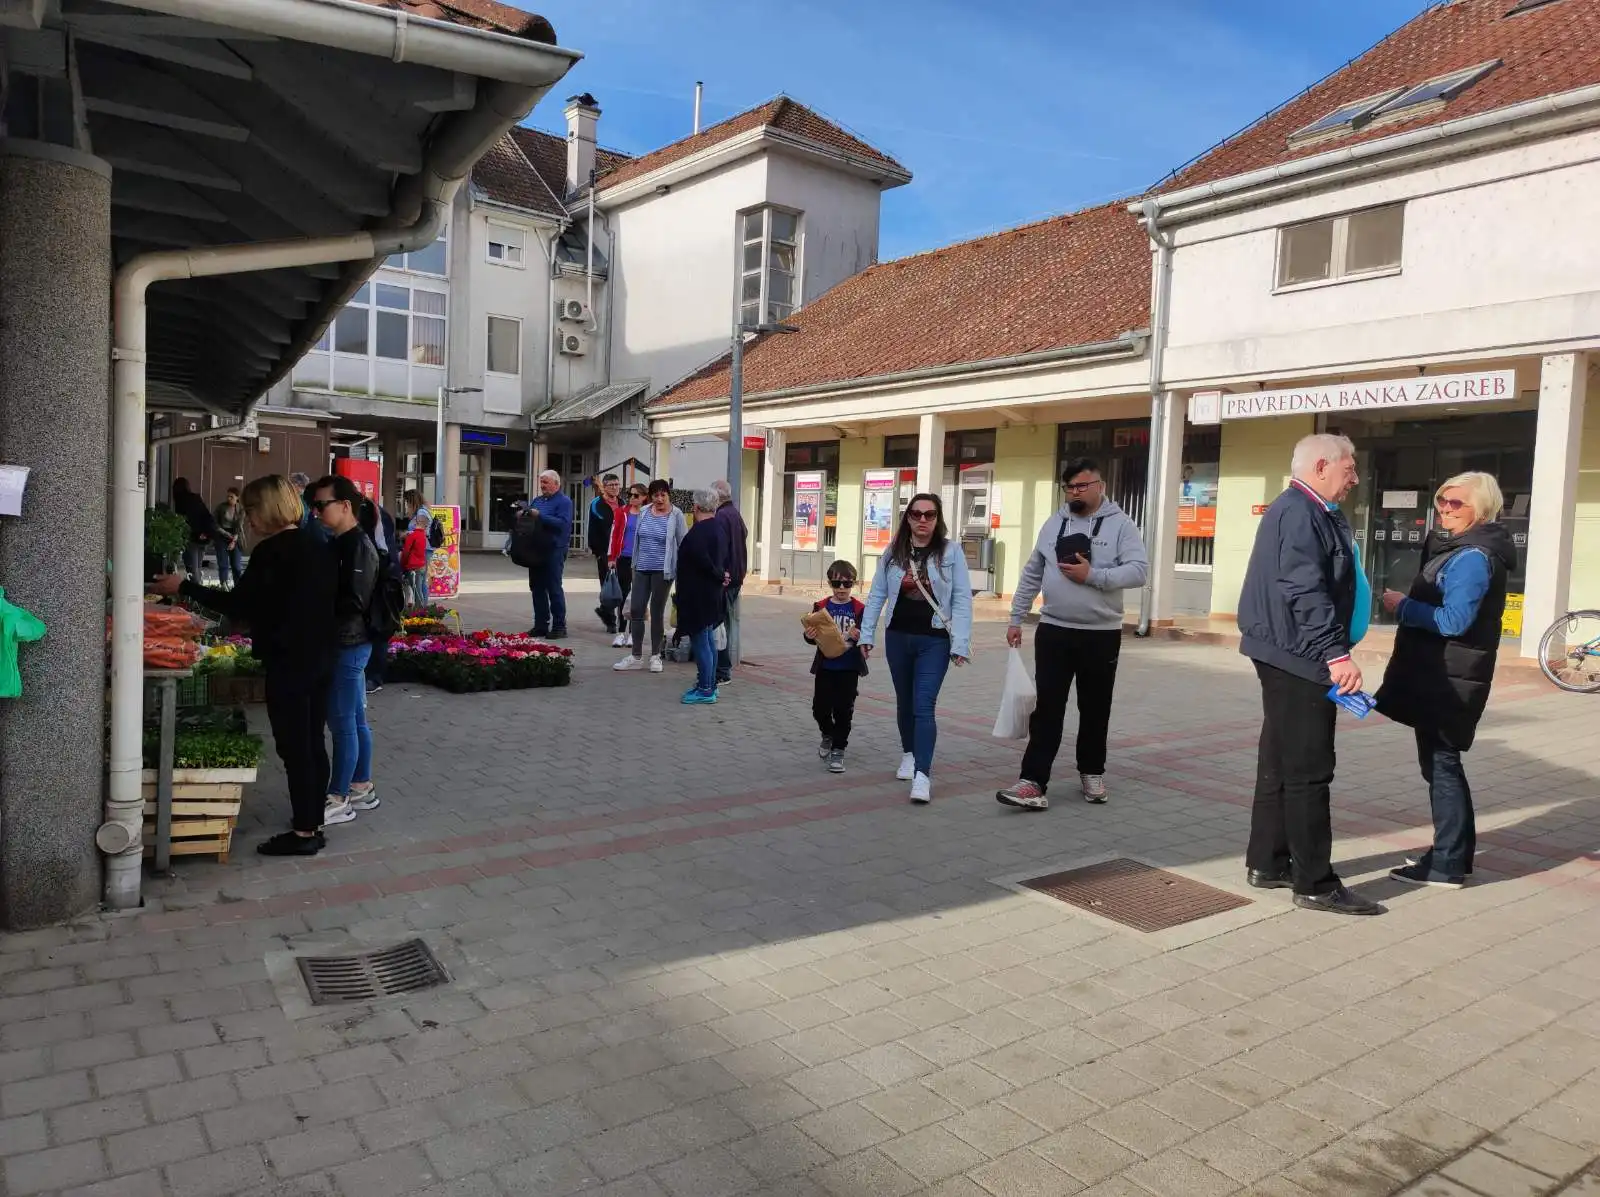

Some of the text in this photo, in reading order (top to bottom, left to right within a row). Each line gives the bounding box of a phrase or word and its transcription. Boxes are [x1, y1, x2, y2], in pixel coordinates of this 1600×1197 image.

[1227, 377, 1506, 415] PRIVREDNA BANKA ZAGREB
